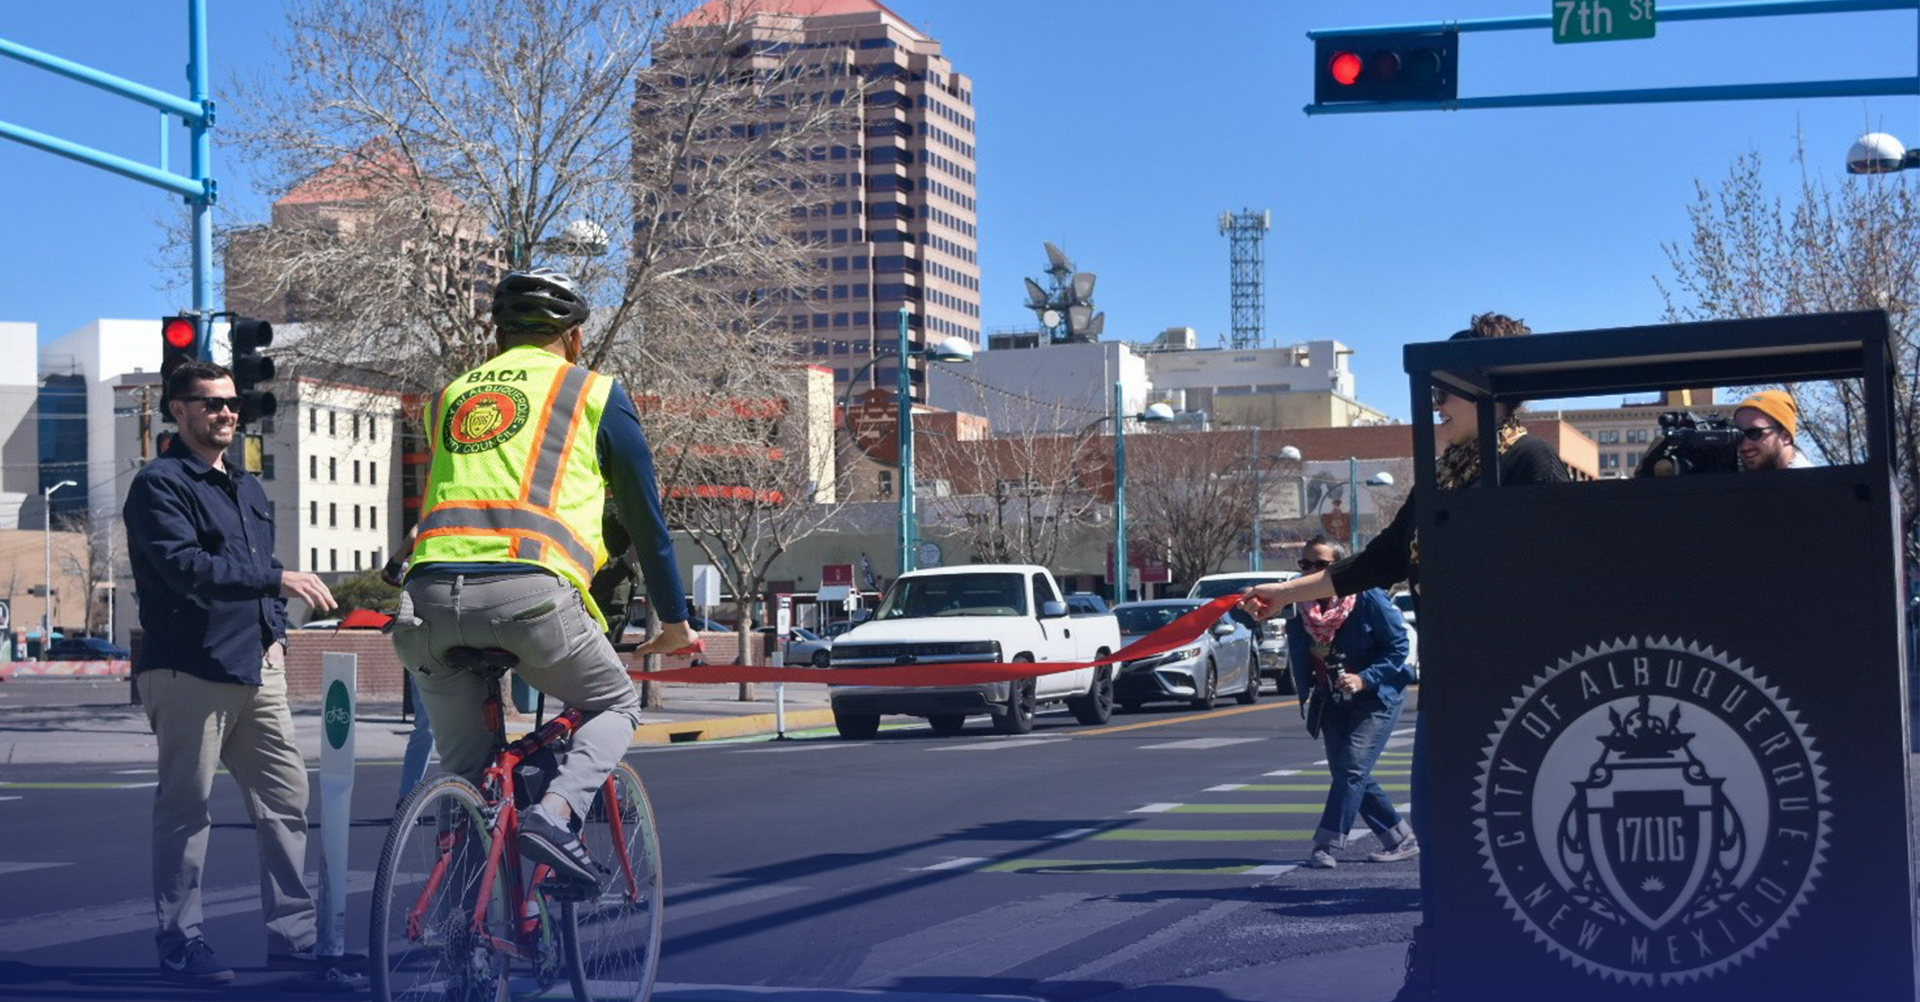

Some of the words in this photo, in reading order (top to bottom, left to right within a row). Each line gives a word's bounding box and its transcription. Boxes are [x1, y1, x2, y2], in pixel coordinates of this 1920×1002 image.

[1555, 0, 1612, 36] 7th
[1629, 0, 1652, 20] St
[466, 370, 528, 383] BACA
[463, 430, 515, 453] COUNCIL
[1493, 758, 1528, 849] CITY
[1520, 695, 1561, 739] OF
[1580, 657, 1809, 842] ALBUQUERQUE
[1524, 882, 1603, 950] NEW
[1631, 877, 1787, 965] MEXICO
